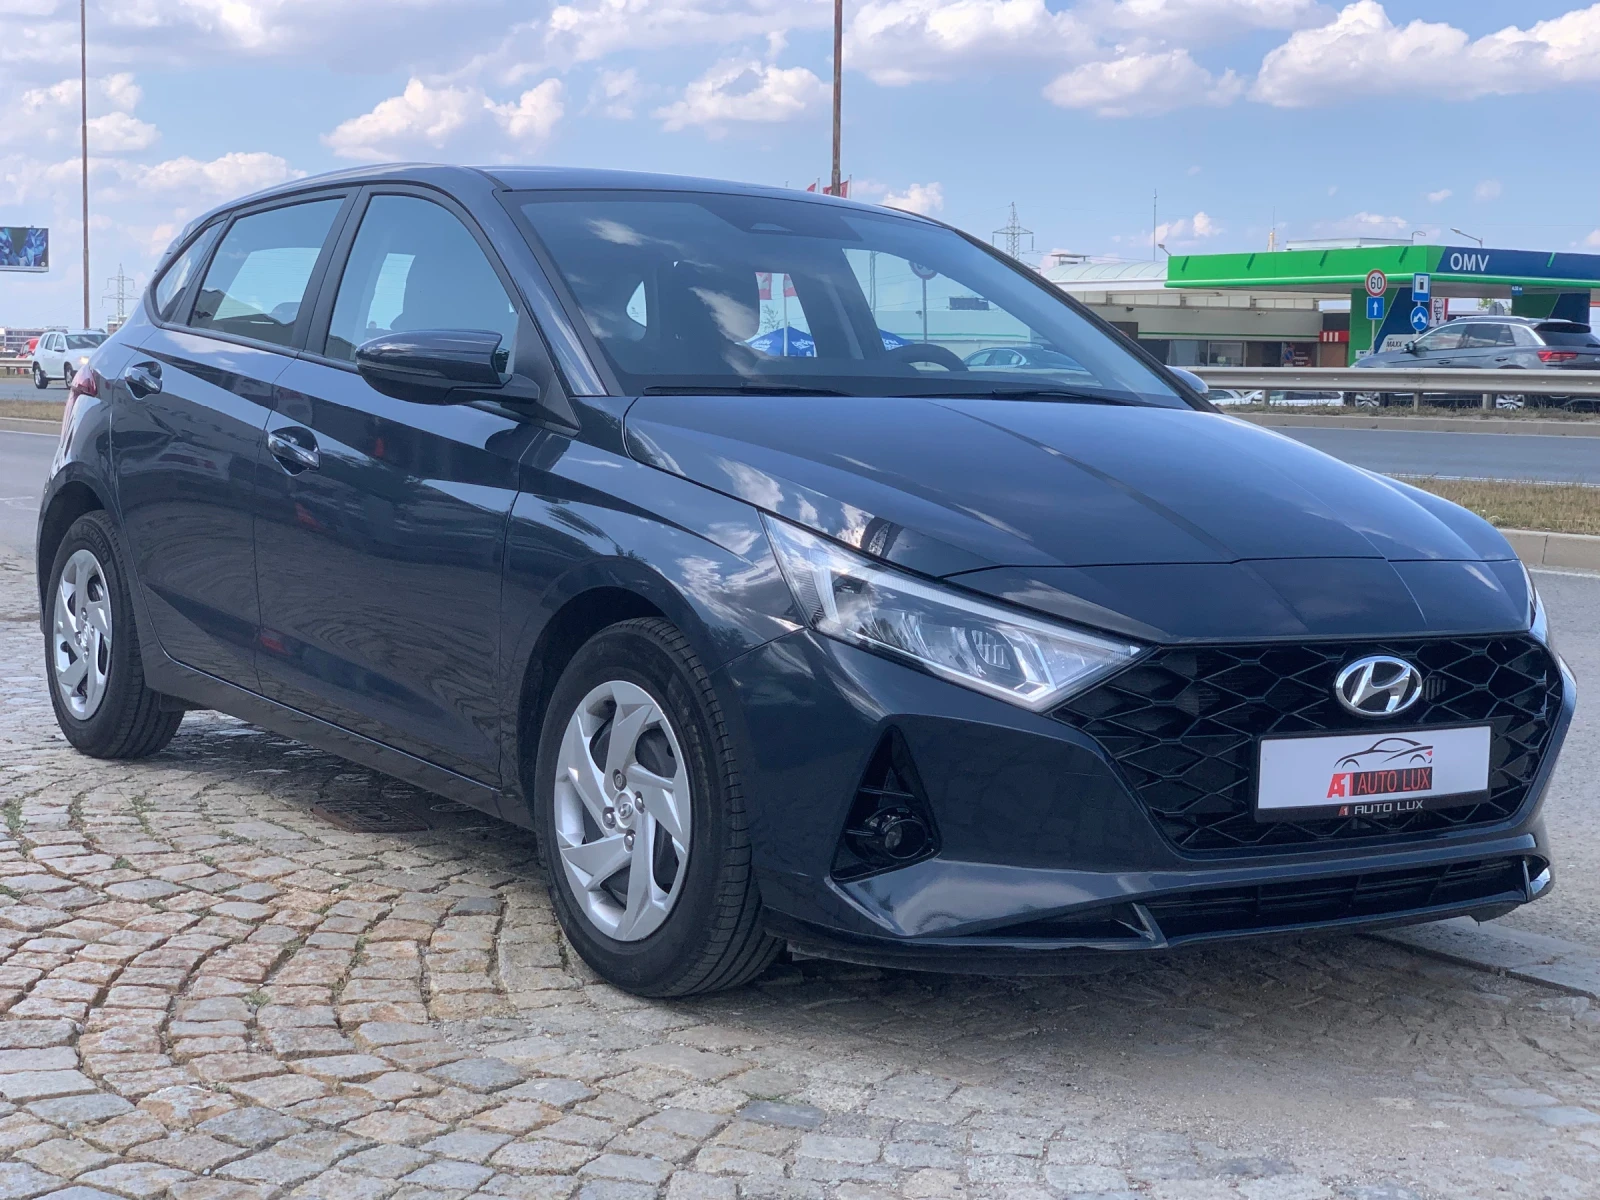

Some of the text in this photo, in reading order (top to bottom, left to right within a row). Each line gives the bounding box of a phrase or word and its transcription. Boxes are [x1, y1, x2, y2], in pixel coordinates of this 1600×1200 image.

[1450, 252, 1490, 272] OMV
[1370, 276, 1383, 290] 60
[1326, 768, 1431, 798] A1 AUTO LUX
[1354, 802, 1393, 815] AUTO
[1397, 799, 1423, 811] LUX
